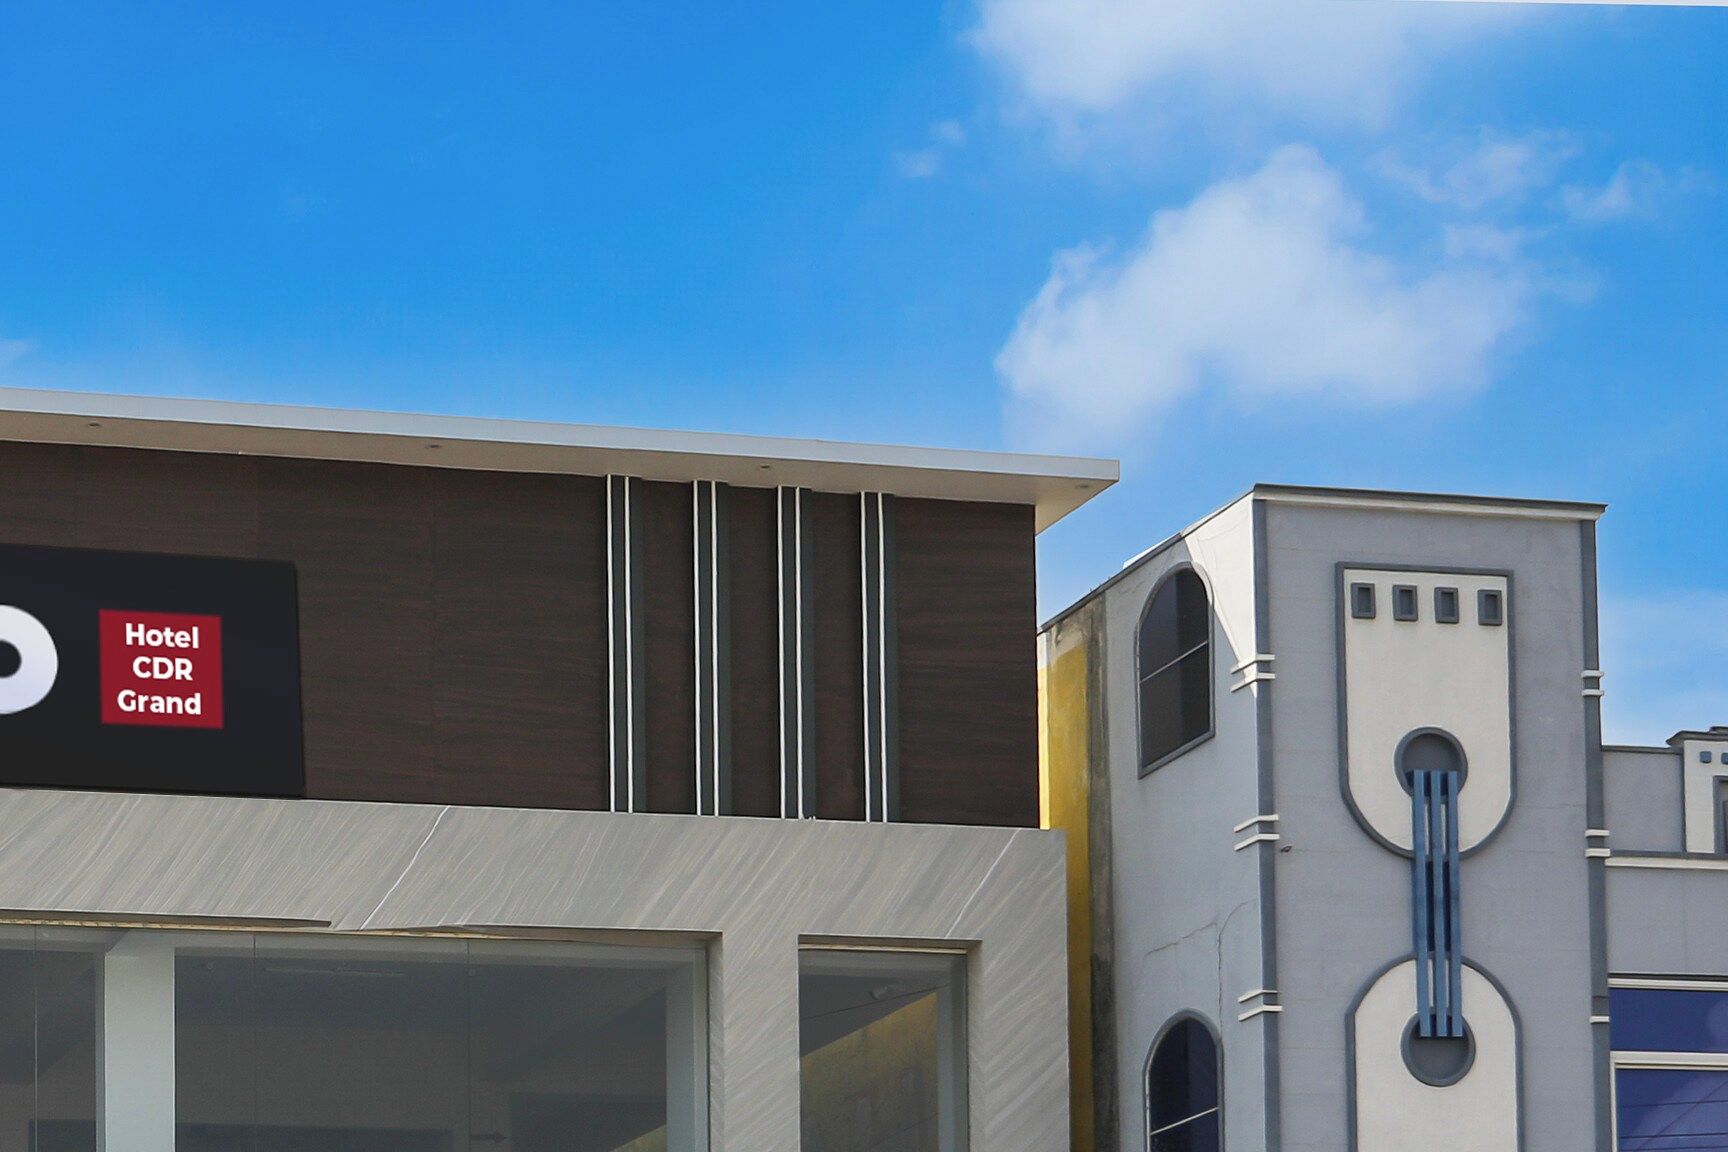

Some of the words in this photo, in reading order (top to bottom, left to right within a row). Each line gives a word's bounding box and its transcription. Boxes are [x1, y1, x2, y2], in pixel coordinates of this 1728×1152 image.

[125, 622, 199, 649] Hotel
[132, 656, 193, 681] CDR
[117, 689, 202, 715] Grand
